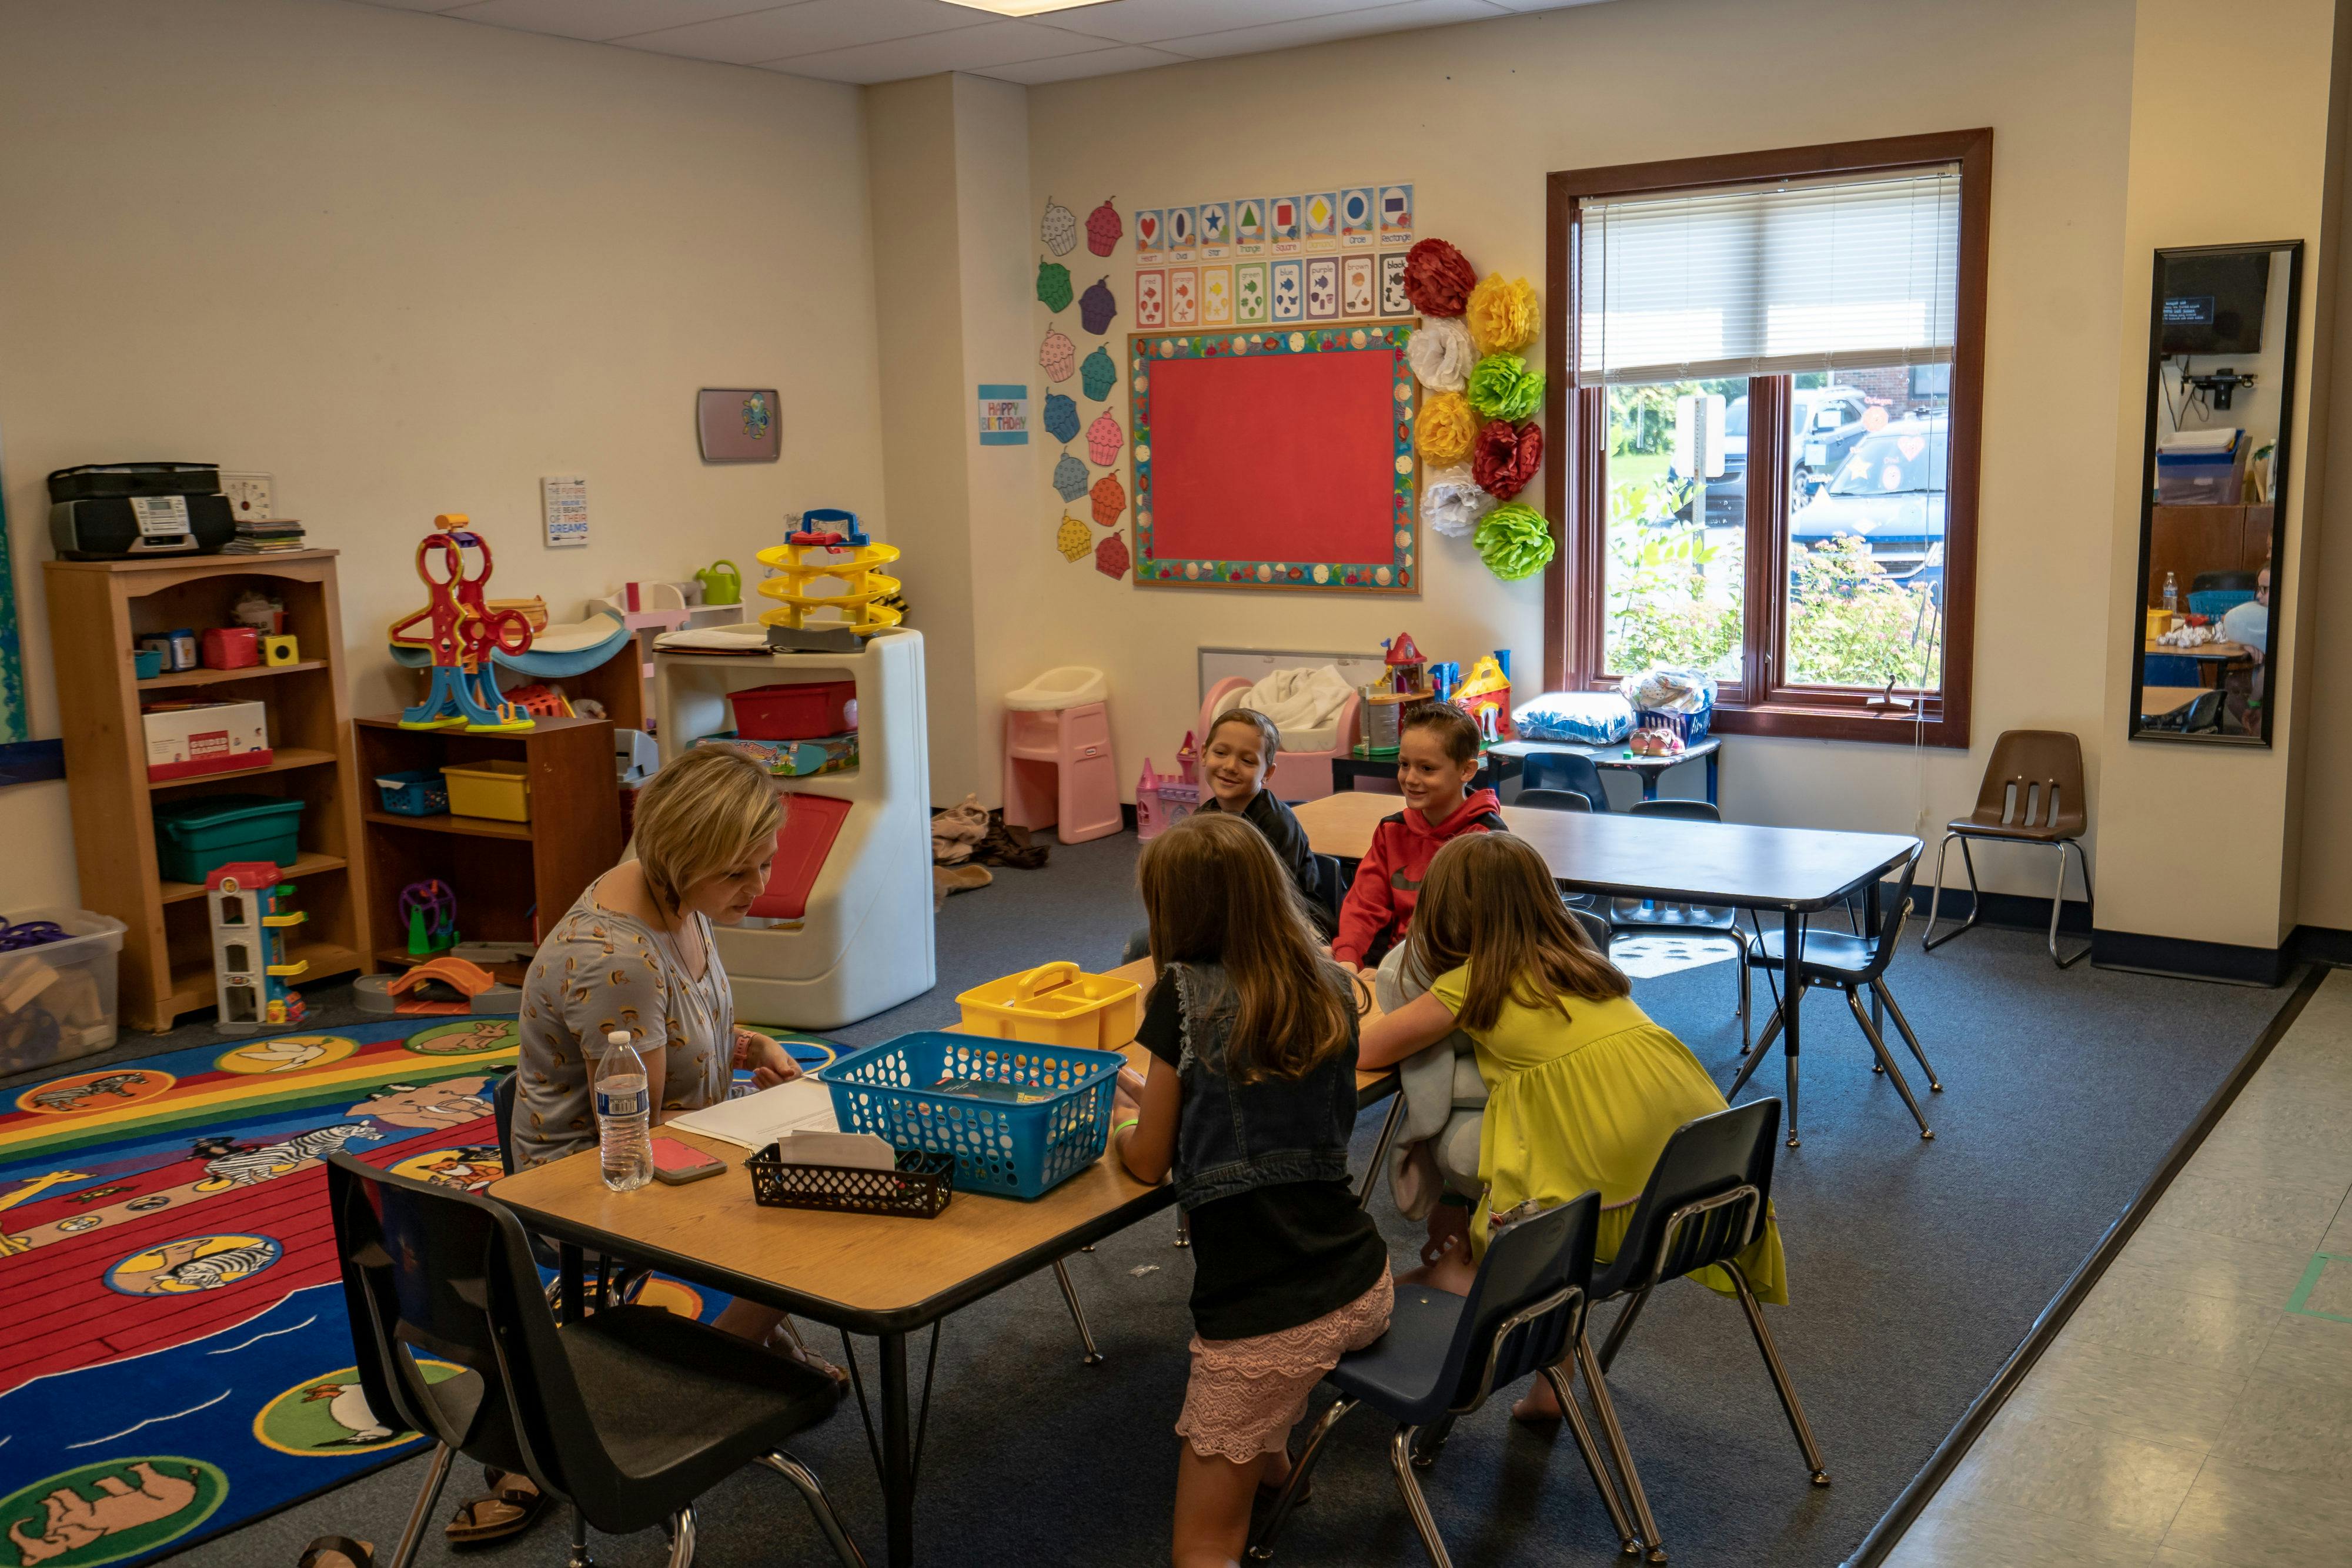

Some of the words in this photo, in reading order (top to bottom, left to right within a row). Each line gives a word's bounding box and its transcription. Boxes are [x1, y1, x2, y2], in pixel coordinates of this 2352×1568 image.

[1349, 236, 1366, 245] Circle
[1382, 233, 1412, 243] Rectangle
[1240, 245, 1261, 253] Triangle
[1275, 243, 1297, 252] Square
[1347, 263, 1370, 272] brown
[1387, 259, 1406, 269] black
[1279, 268, 1294, 276] blue
[1312, 265, 1334, 275] purple
[1242, 272, 1260, 280] green
[1864, 396, 1892, 405] Octagon
[988, 403, 1018, 415] HAPPY
[982, 417, 1026, 430] BIRTHDAY
[563, 514, 587, 522] THEIR
[549, 523, 587, 533] DREAMS
[190, 737, 228, 748] GUIDED
